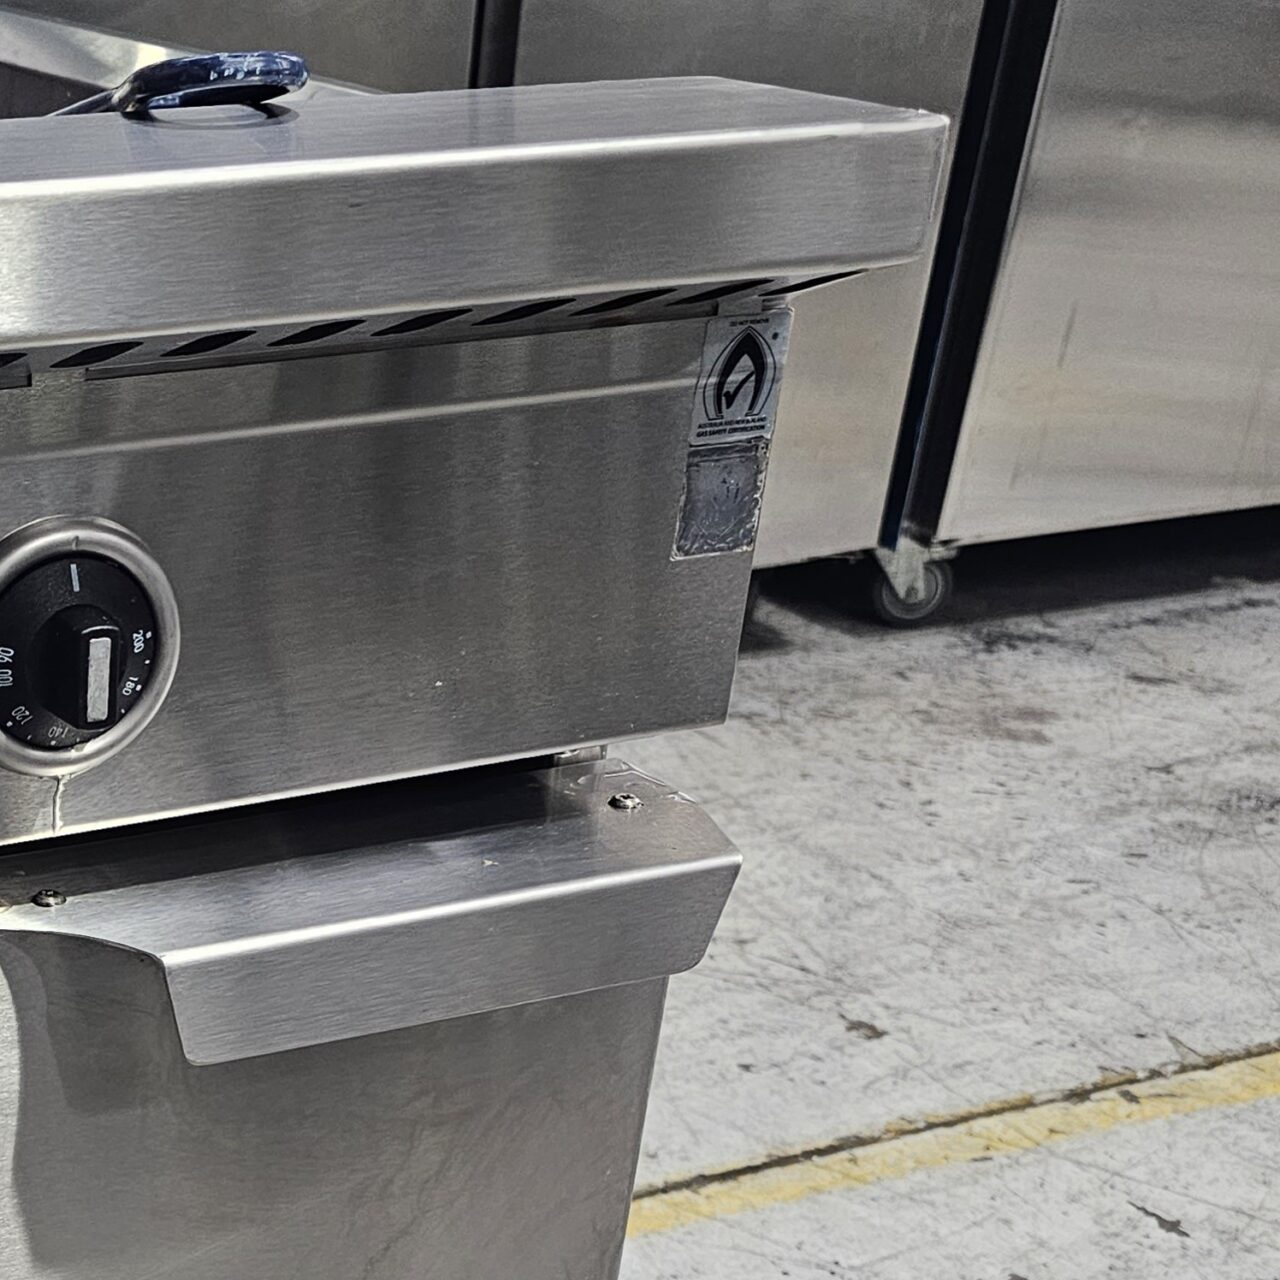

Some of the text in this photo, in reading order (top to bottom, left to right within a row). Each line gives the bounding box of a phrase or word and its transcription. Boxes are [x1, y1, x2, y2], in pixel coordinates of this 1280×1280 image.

[132, 629, 145, 653] 200
[122, 676, 139, 696] 180
[11, 706, 34, 725] 120
[47, 726, 69, 738] 140
